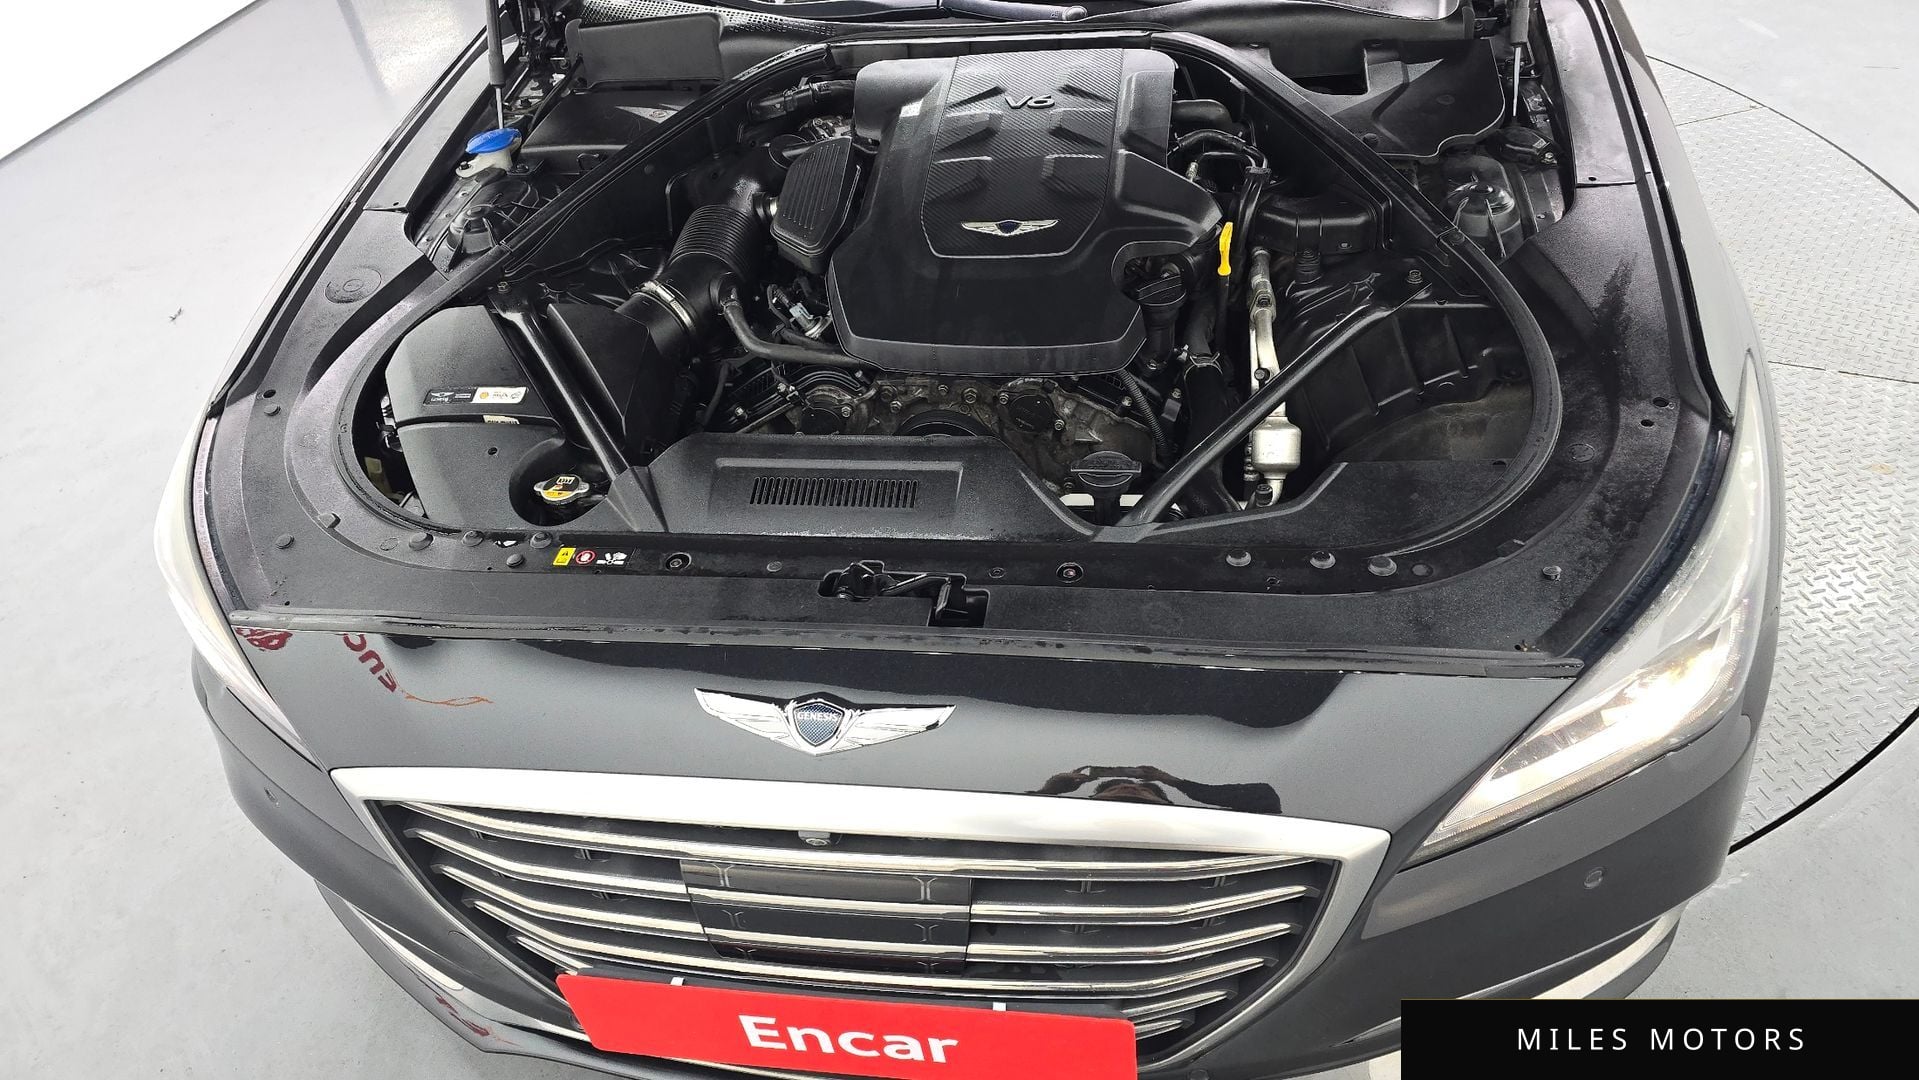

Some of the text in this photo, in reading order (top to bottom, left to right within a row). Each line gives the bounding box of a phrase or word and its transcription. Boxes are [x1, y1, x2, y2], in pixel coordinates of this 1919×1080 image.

[1004, 95, 1055, 109] V6
[798, 711, 839, 722] GENESIS
[738, 1014, 959, 1064] Encar
